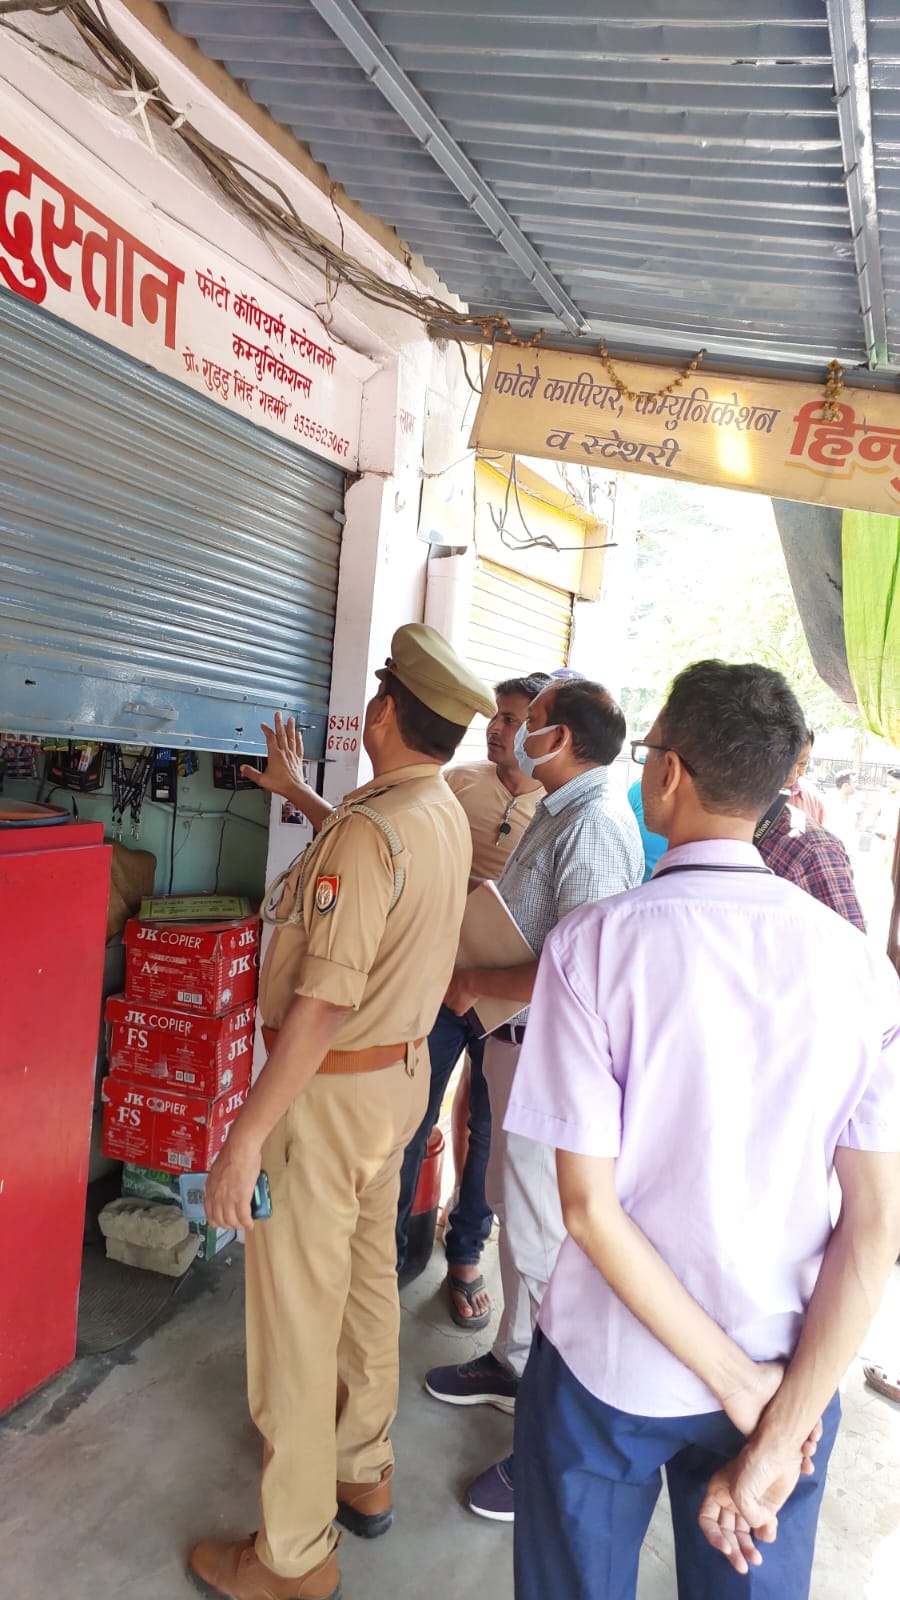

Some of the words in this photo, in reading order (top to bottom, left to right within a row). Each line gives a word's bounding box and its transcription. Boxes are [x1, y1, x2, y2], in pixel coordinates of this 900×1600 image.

[195, 268, 231, 312] फोटो
[290, 328, 336, 375] स्टेशनरी
[494, 363, 541, 399] फोटो
[546, 429, 575, 451] व
[580, 430, 682, 467] स्टेशरी
[328, 715, 360, 732] 8314
[327, 735, 358, 752] 6760
[754, 819, 772, 839] Nikon
[137, 927, 159, 942] JK
[160, 931, 203, 950] COPIER
[238, 929, 255, 947] JK
[141, 960, 160, 975] A4
[228, 954, 251, 978] JK
[124, 1010, 147, 1026] JK
[149, 1014, 192, 1035] COPIER
[234, 1007, 251, 1031] JK
[127, 1027, 149, 1049] FS
[228, 1035, 249, 1061] JK
[124, 1092, 145, 1107] JK
[146, 1097, 187, 1116] COPIER
[226, 1090, 244, 1114] JK
[117, 1106, 142, 1127] FS
